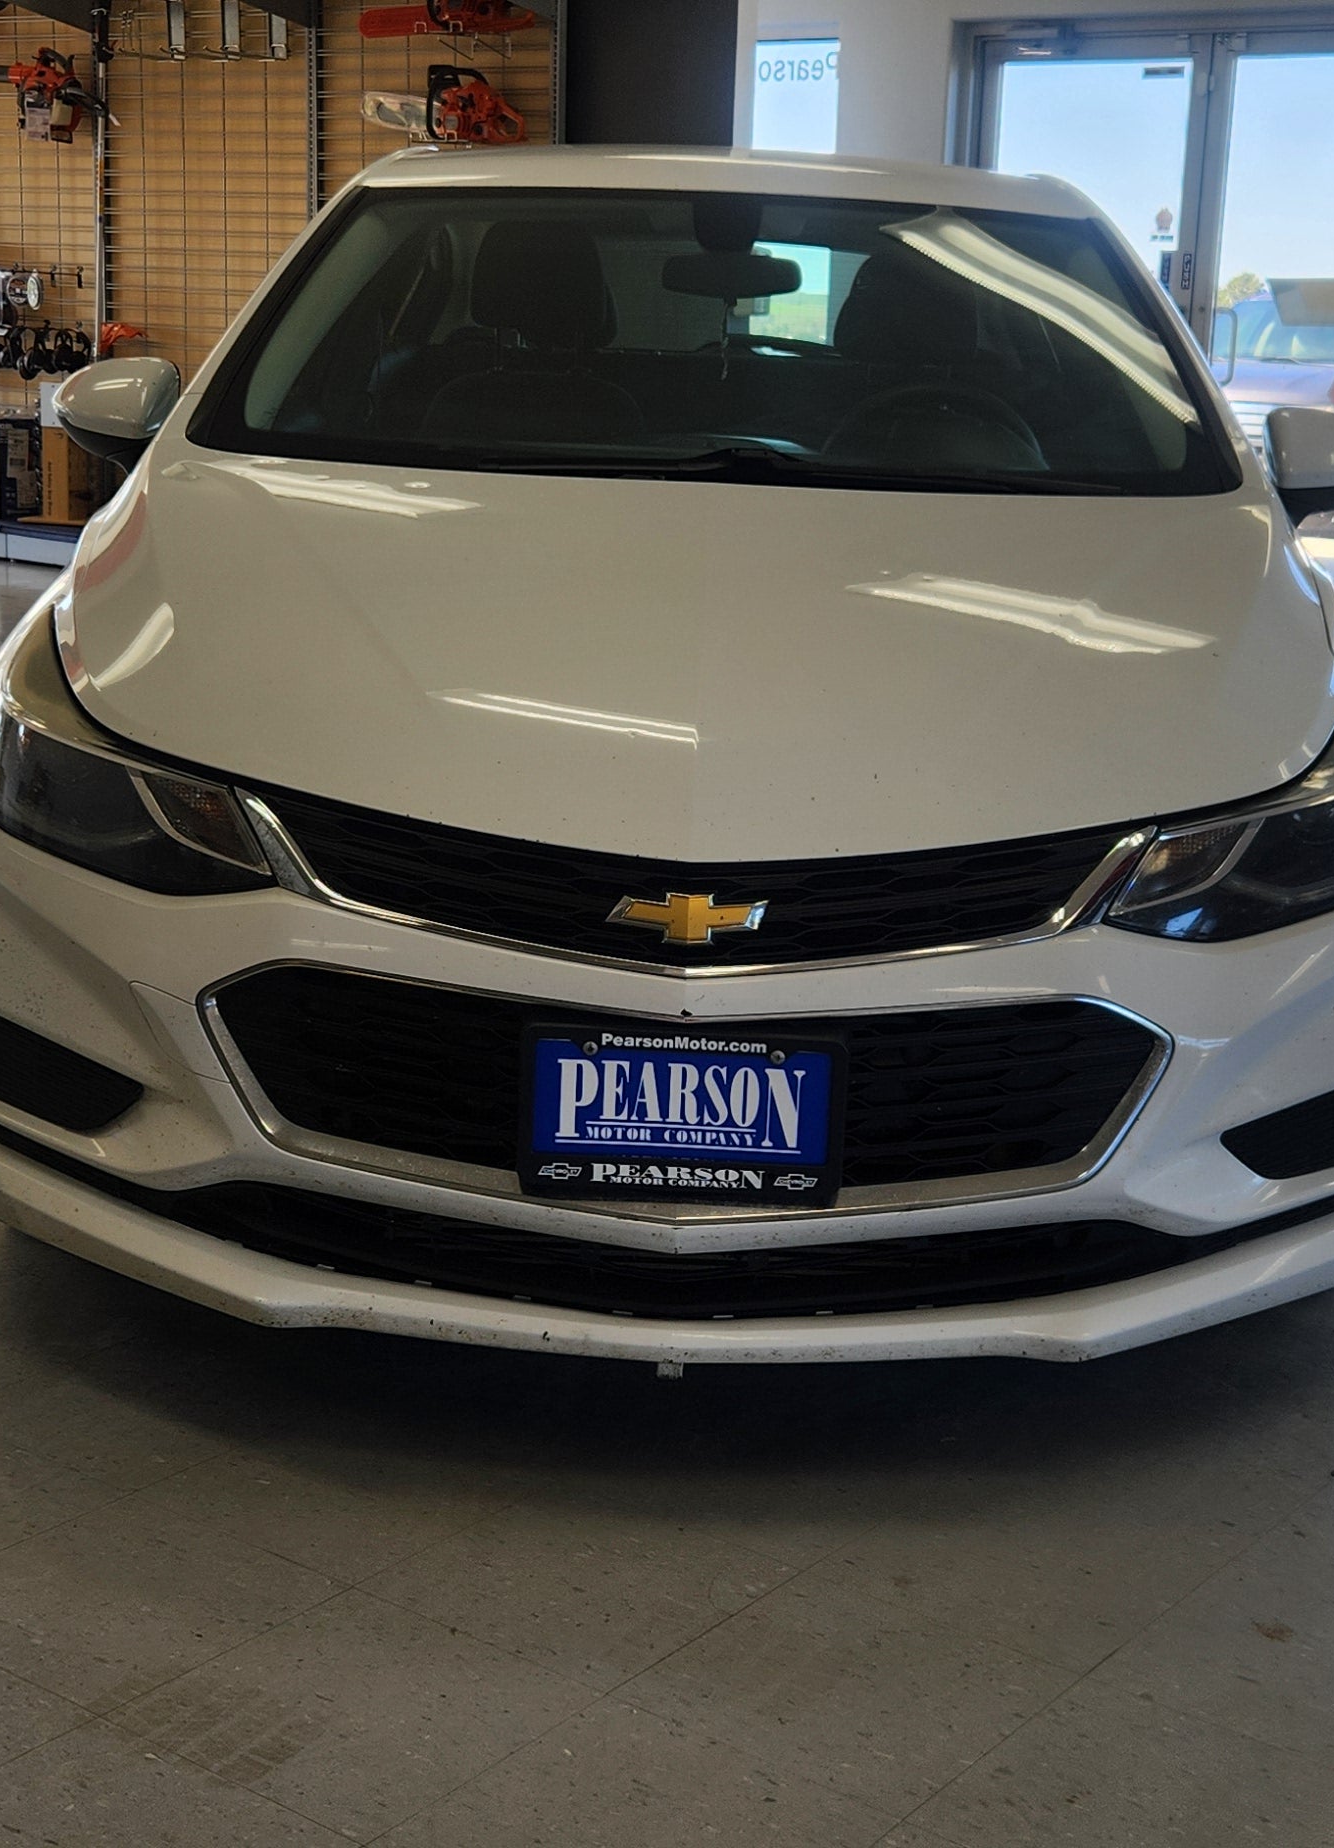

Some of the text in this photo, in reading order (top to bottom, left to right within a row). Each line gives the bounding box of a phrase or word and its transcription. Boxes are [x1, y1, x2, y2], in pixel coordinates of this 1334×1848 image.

[1181, 255, 1191, 288] PUSH
[601, 1033, 768, 1054] PearsonMotor.com
[555, 1058, 807, 1148] PEARSON
[585, 1126, 757, 1146] MOTOR COMPANY
[589, 1163, 766, 1190] PEARSON
[610, 1176, 741, 1189] MOTOR COMPANY
